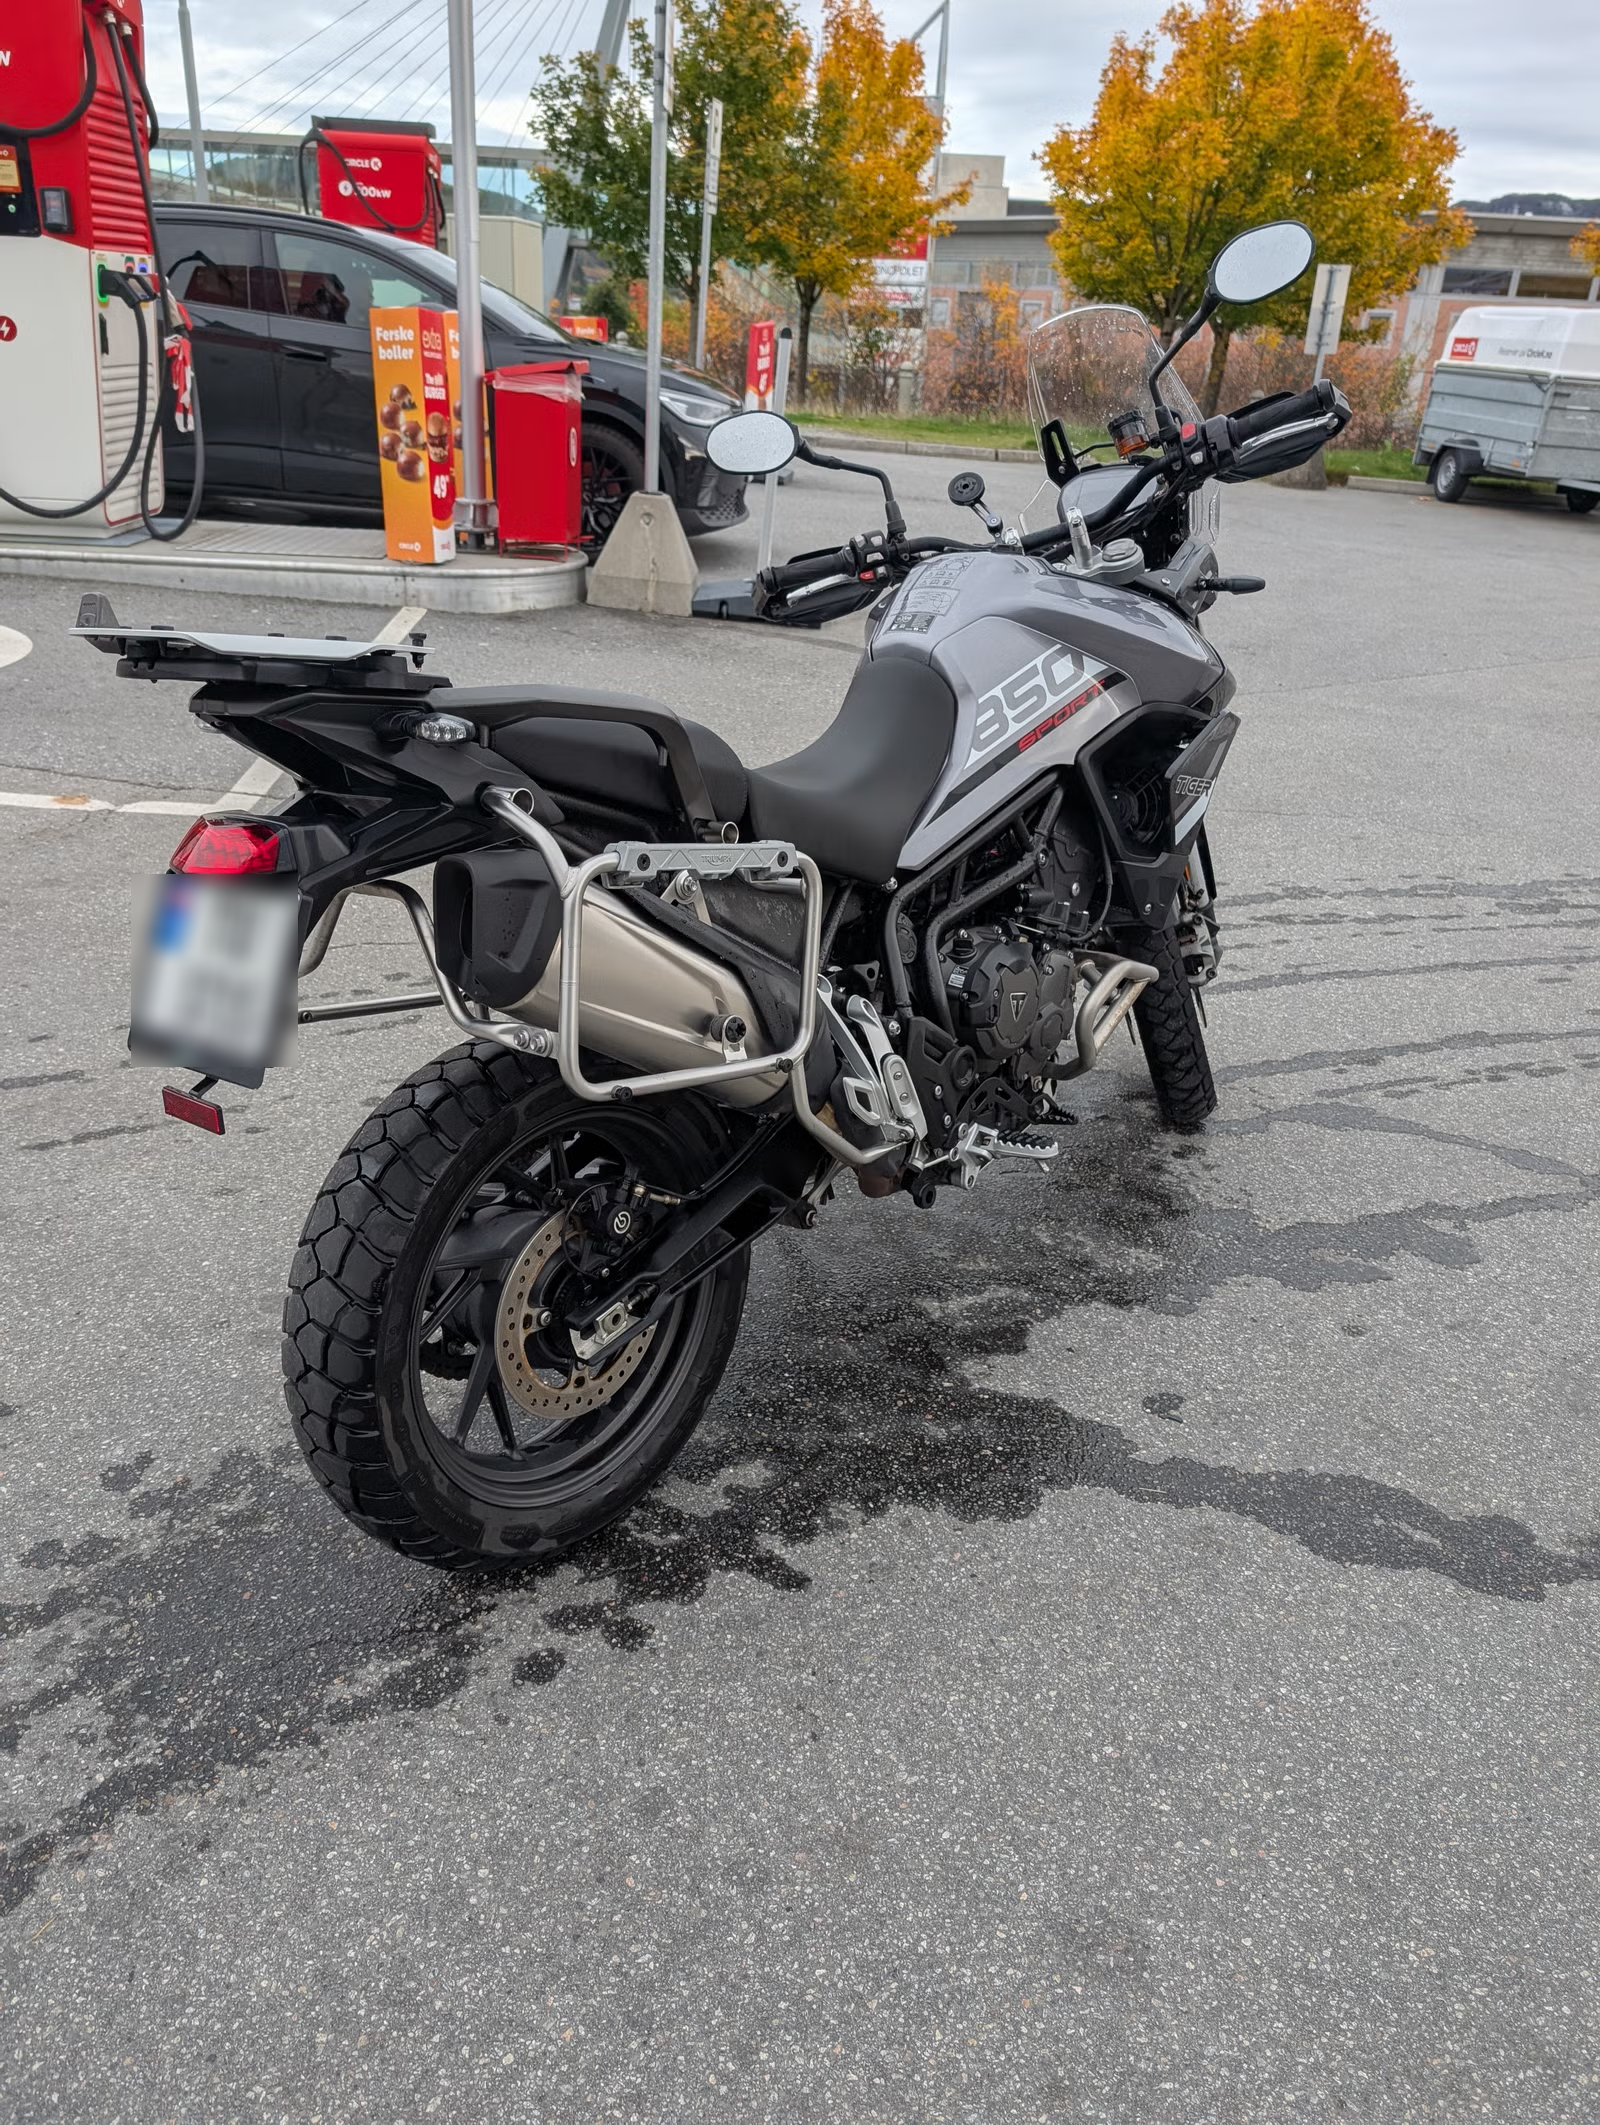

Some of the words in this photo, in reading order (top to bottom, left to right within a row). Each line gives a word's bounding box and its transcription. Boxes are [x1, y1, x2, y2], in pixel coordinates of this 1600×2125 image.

[376, 325, 414, 342] Ferske
[378, 344, 414, 360] boller
[970, 648, 1085, 753] 850
[1018, 680, 1106, 753] SPORT
[1175, 774, 1214, 797] TIGER
